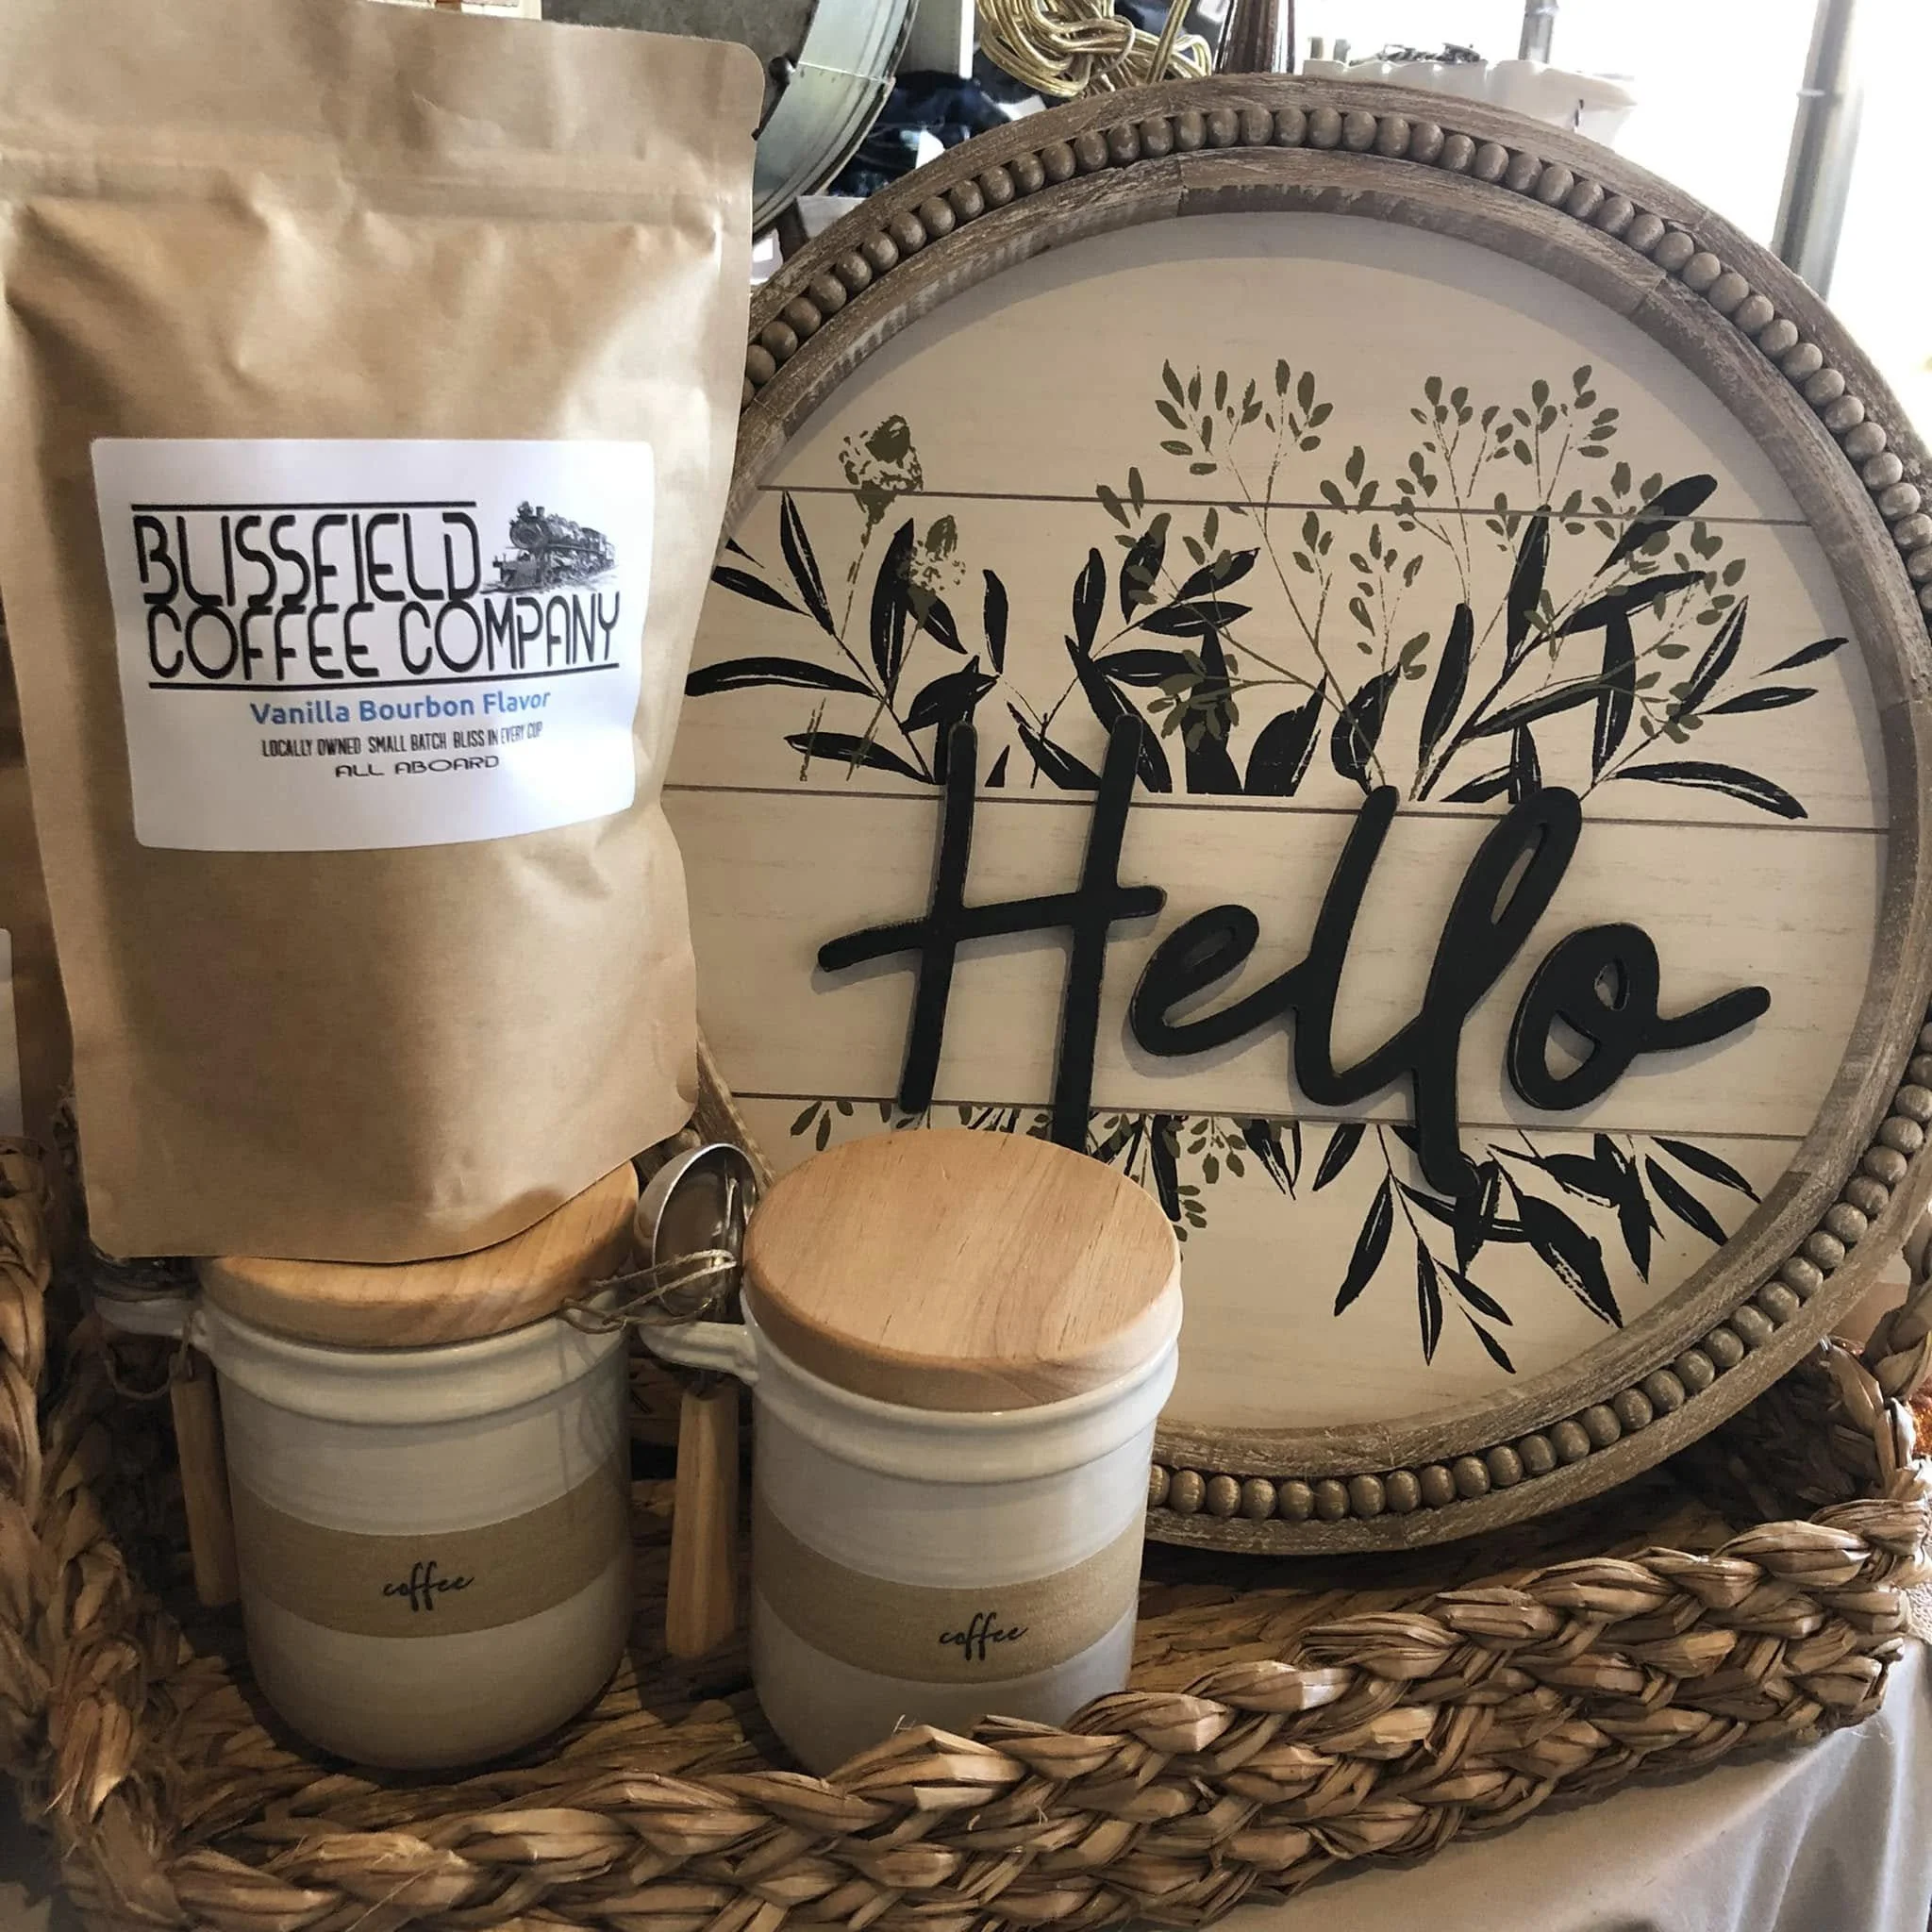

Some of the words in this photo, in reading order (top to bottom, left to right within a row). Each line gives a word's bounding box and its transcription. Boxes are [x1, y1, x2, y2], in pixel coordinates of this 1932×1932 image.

[133, 512, 482, 608] BLISSFIELD
[147, 601, 380, 681] COFFEE
[398, 591, 621, 675] COMPANY
[249, 700, 351, 724] Vanilla
[358, 694, 475, 722] Bourbon
[482, 690, 552, 715] Flavor
[261, 738, 312, 757] LOCALLY
[317, 736, 362, 756] OWNED
[368, 734, 407, 754] SMALL
[410, 731, 447, 752] BATCH
[453, 728, 485, 749] BLISS
[488, 727, 499, 746] IN
[500, 724, 525, 744] EVERY
[526, 720, 544, 740] CUP
[335, 762, 386, 778] ALL
[394, 754, 501, 775] ABOARD
[817, 715, 1772, 1198] Hello
[382, 1559, 475, 1613] coffee
[939, 1611, 1029, 1662] coffee
